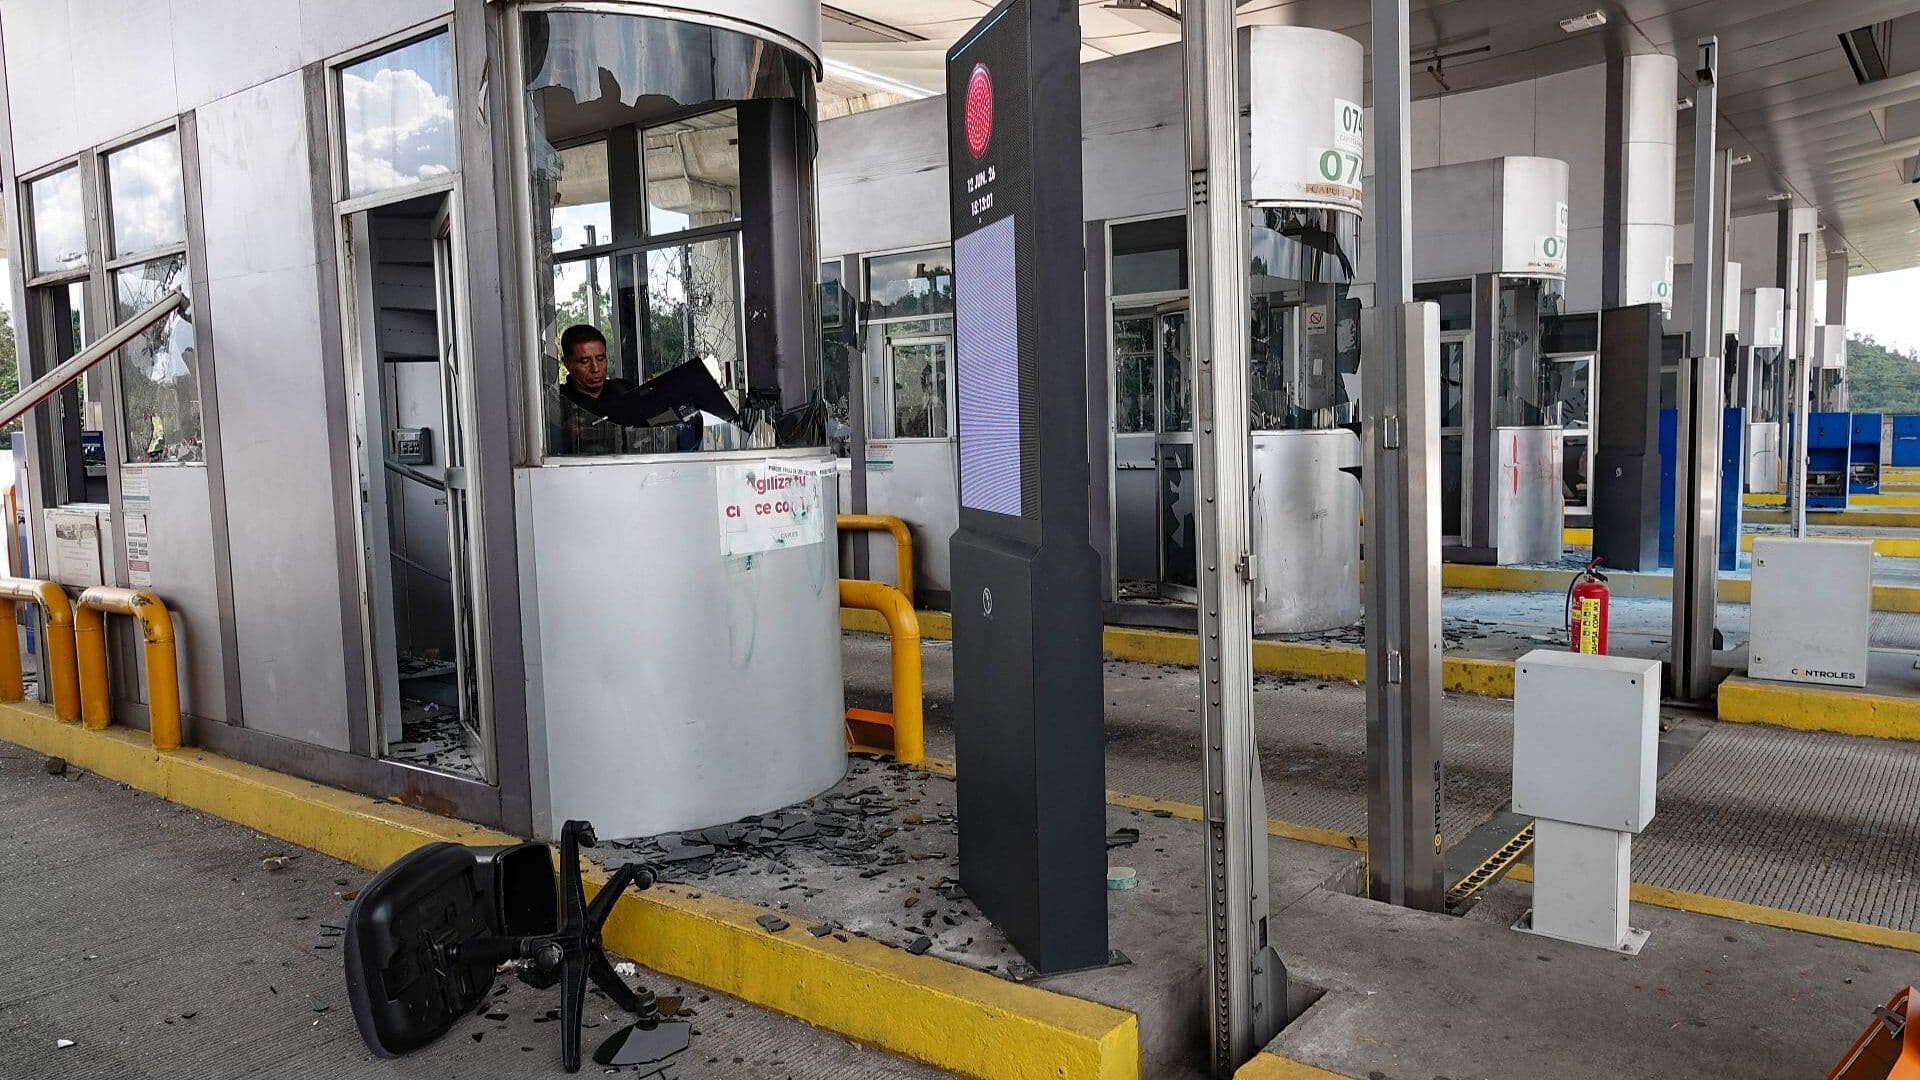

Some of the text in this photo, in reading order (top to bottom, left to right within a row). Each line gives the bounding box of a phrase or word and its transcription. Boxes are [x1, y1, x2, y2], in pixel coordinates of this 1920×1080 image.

[967, 177, 974, 193] 12
[988, 165, 996, 182] 26
[1320, 150, 1363, 184] 07
[1792, 668, 1856, 680] CONTROLES
